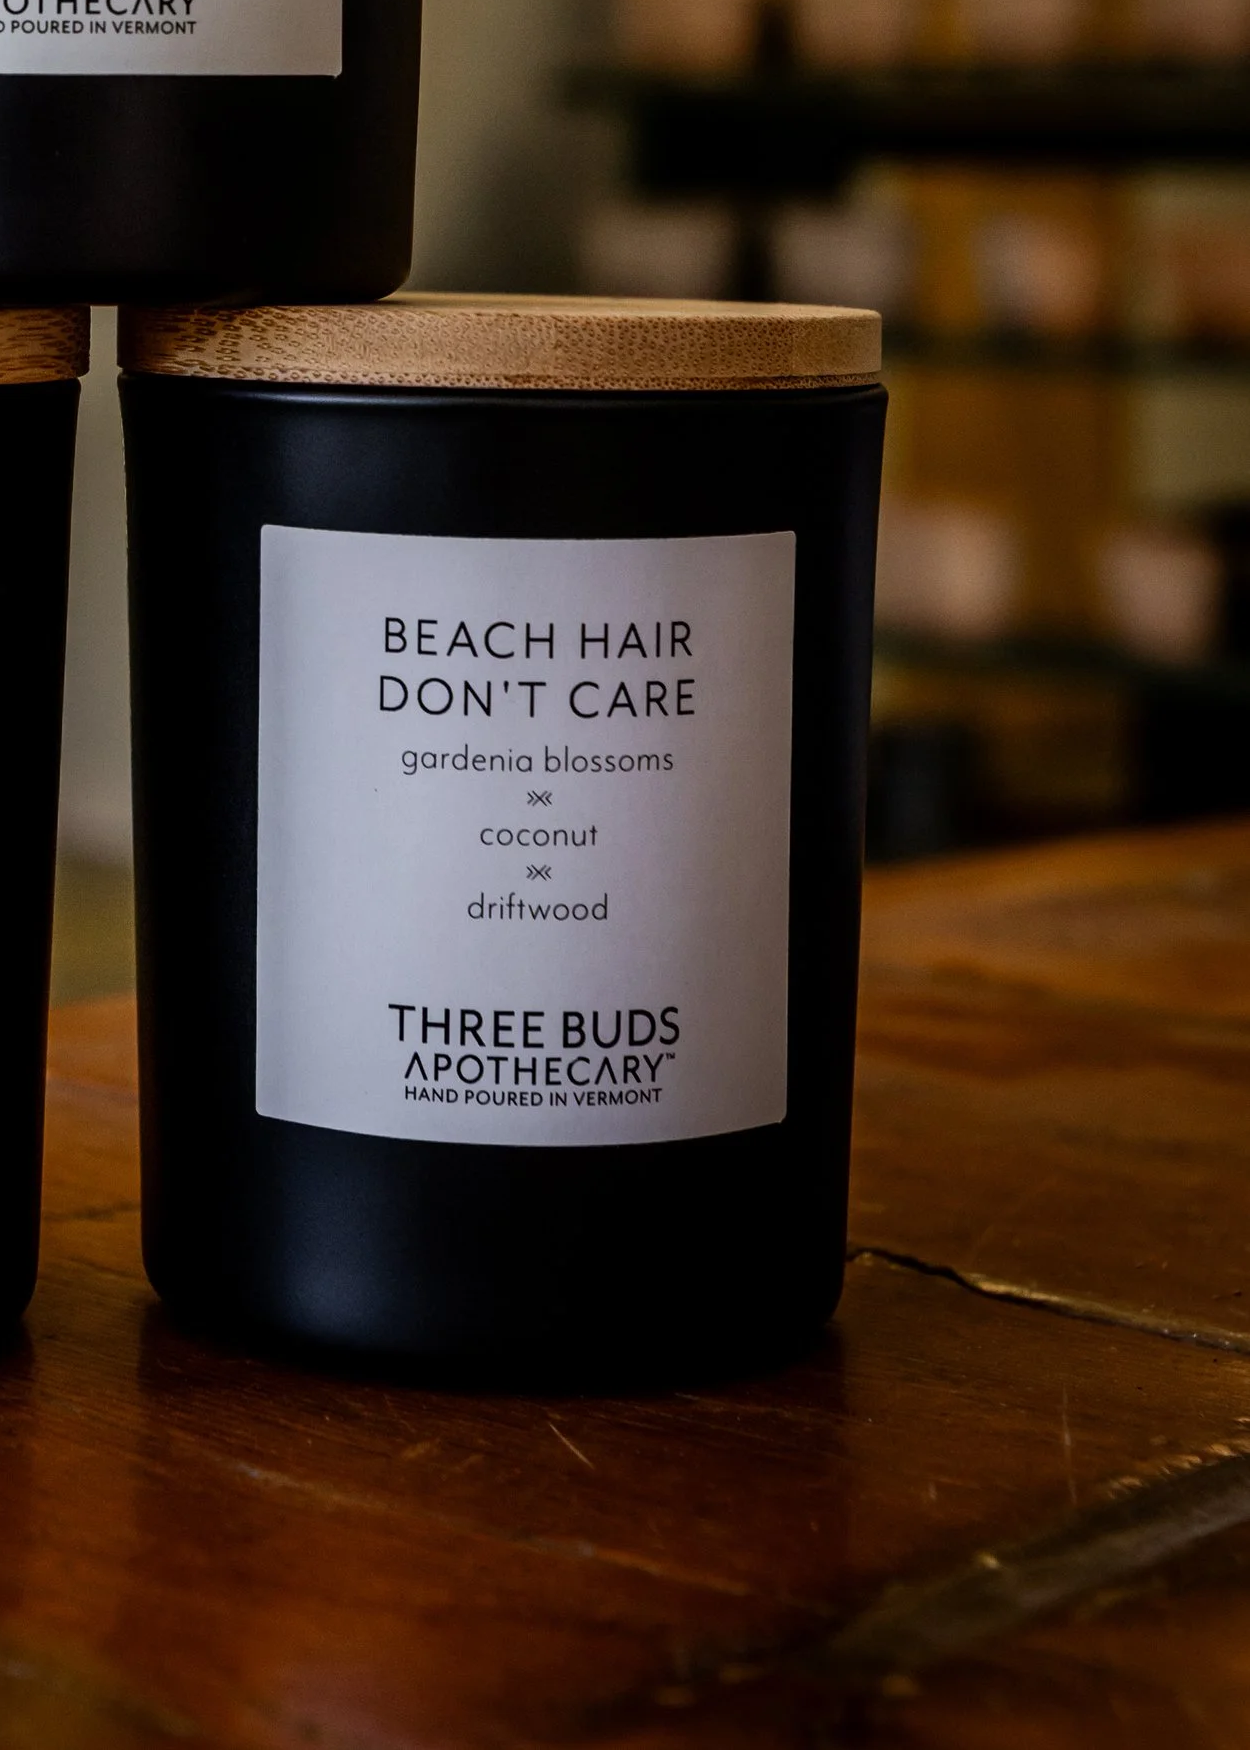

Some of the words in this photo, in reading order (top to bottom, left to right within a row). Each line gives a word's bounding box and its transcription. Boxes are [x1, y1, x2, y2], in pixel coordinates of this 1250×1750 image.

[10, 20, 84, 34] POURED
[90, 21, 106, 34] IN
[112, 20, 196, 34] VERMONT
[384, 617, 554, 660] BEACH
[580, 620, 693, 660] HAIR
[380, 676, 546, 717] DON'T
[569, 679, 695, 719] CARE
[401, 745, 532, 775] gardenia
[545, 746, 673, 773] blossoms
[480, 825, 597, 847] coconut
[467, 893, 608, 921] driftwood
[388, 1003, 544, 1047] THREE
[562, 1006, 680, 1049] BUDS
[404, 1086, 459, 1104] HAND
[465, 1090, 543, 1107] POURED
[549, 1092, 567, 1107] IN
[573, 1088, 662, 1107] VERMONT
